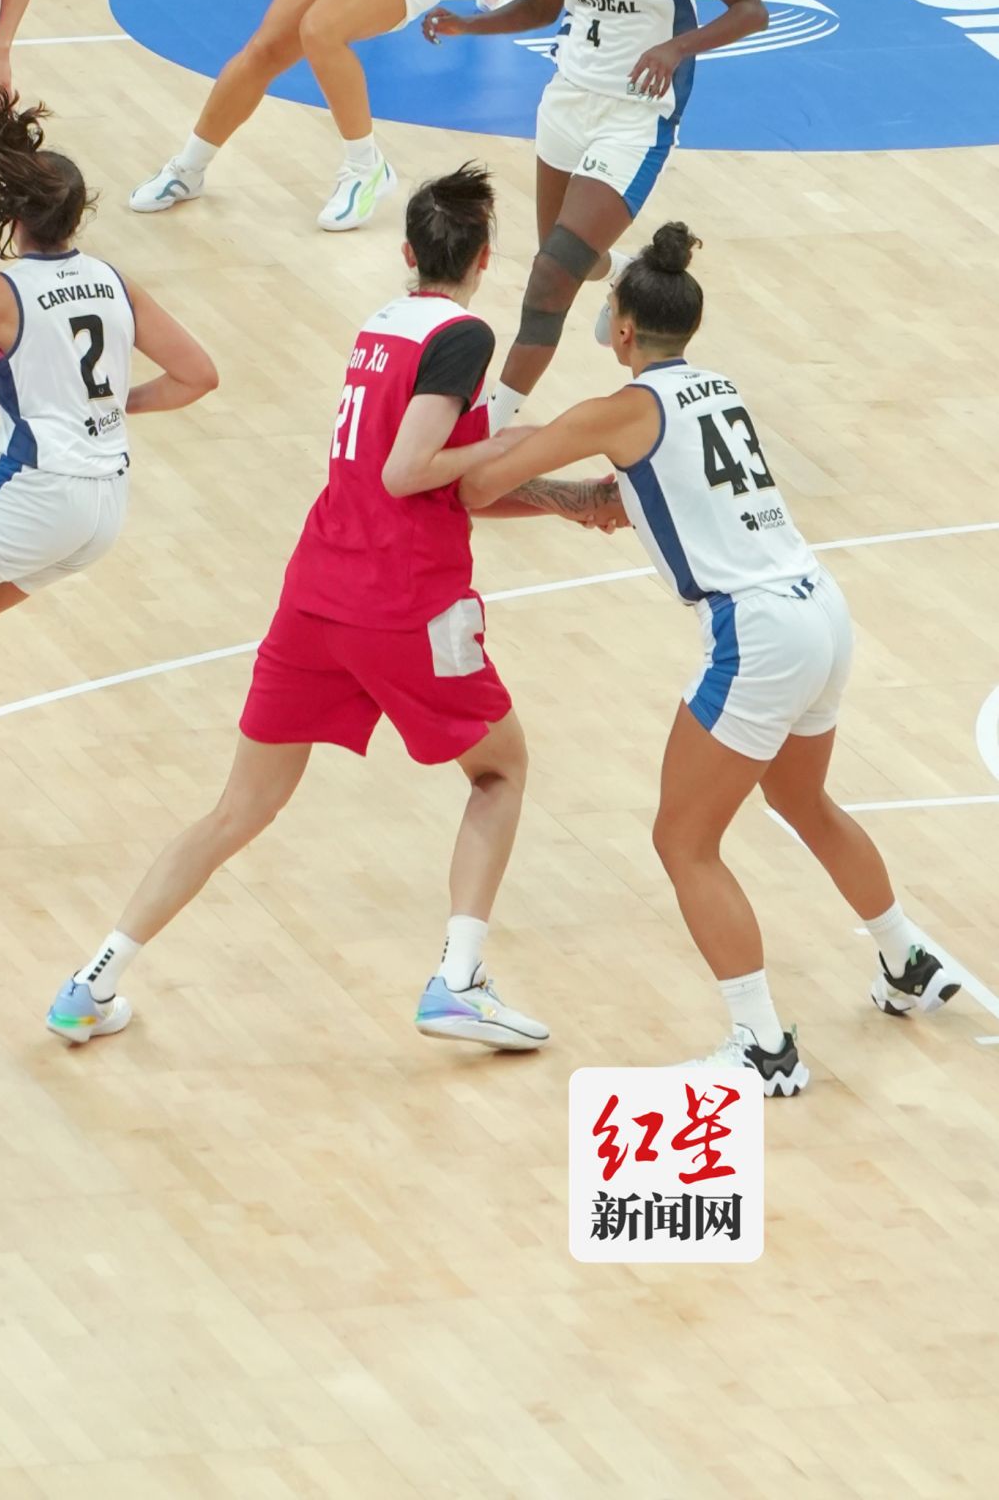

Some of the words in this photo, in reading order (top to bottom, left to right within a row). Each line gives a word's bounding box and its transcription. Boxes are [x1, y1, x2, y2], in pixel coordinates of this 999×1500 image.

[586, 19, 601, 48] 4
[37, 283, 115, 311] CARVALHO
[68, 314, 115, 400] 2
[365, 343, 389, 373] Xu
[675, 380, 738, 409] ALVES
[696, 406, 776, 496] 43
